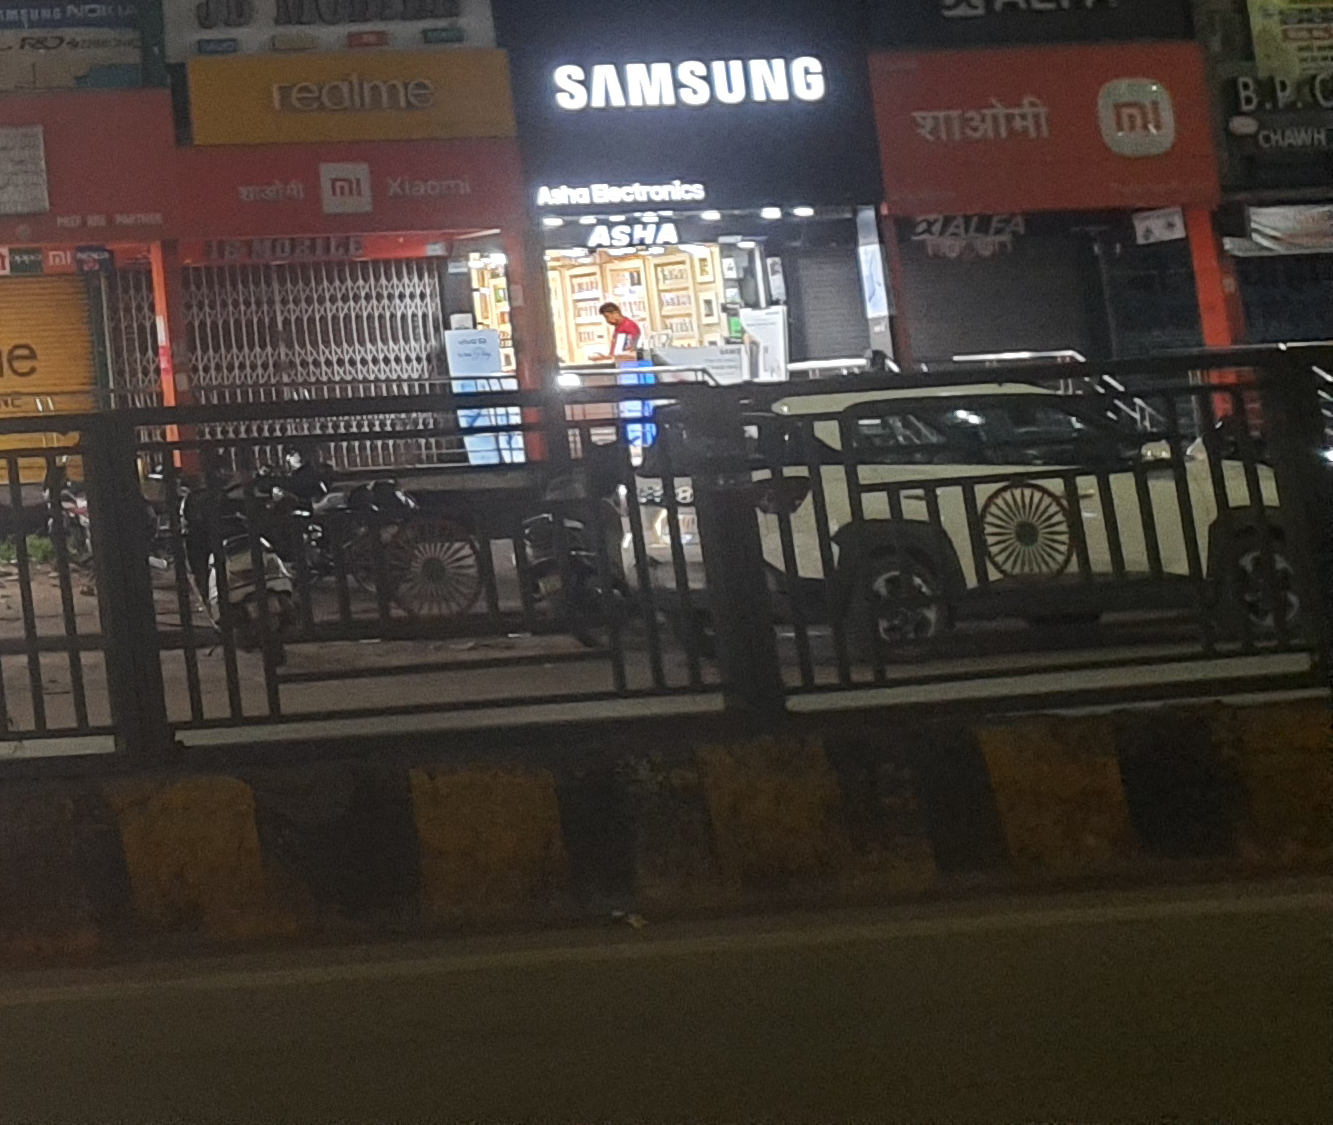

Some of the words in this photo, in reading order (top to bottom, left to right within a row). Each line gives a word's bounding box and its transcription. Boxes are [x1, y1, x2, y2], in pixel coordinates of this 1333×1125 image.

[66, 3, 138, 18] NOKIA
[270, 72, 435, 112] realme
[551, 56, 826, 111] SAMSUNG
[911, 91, 1051, 141] शाओमी
[386, 174, 472, 199] Xiaomi
[536, 184, 591, 207] Asha
[590, 179, 706, 204] Electronics
[586, 222, 679, 248] ASHA
